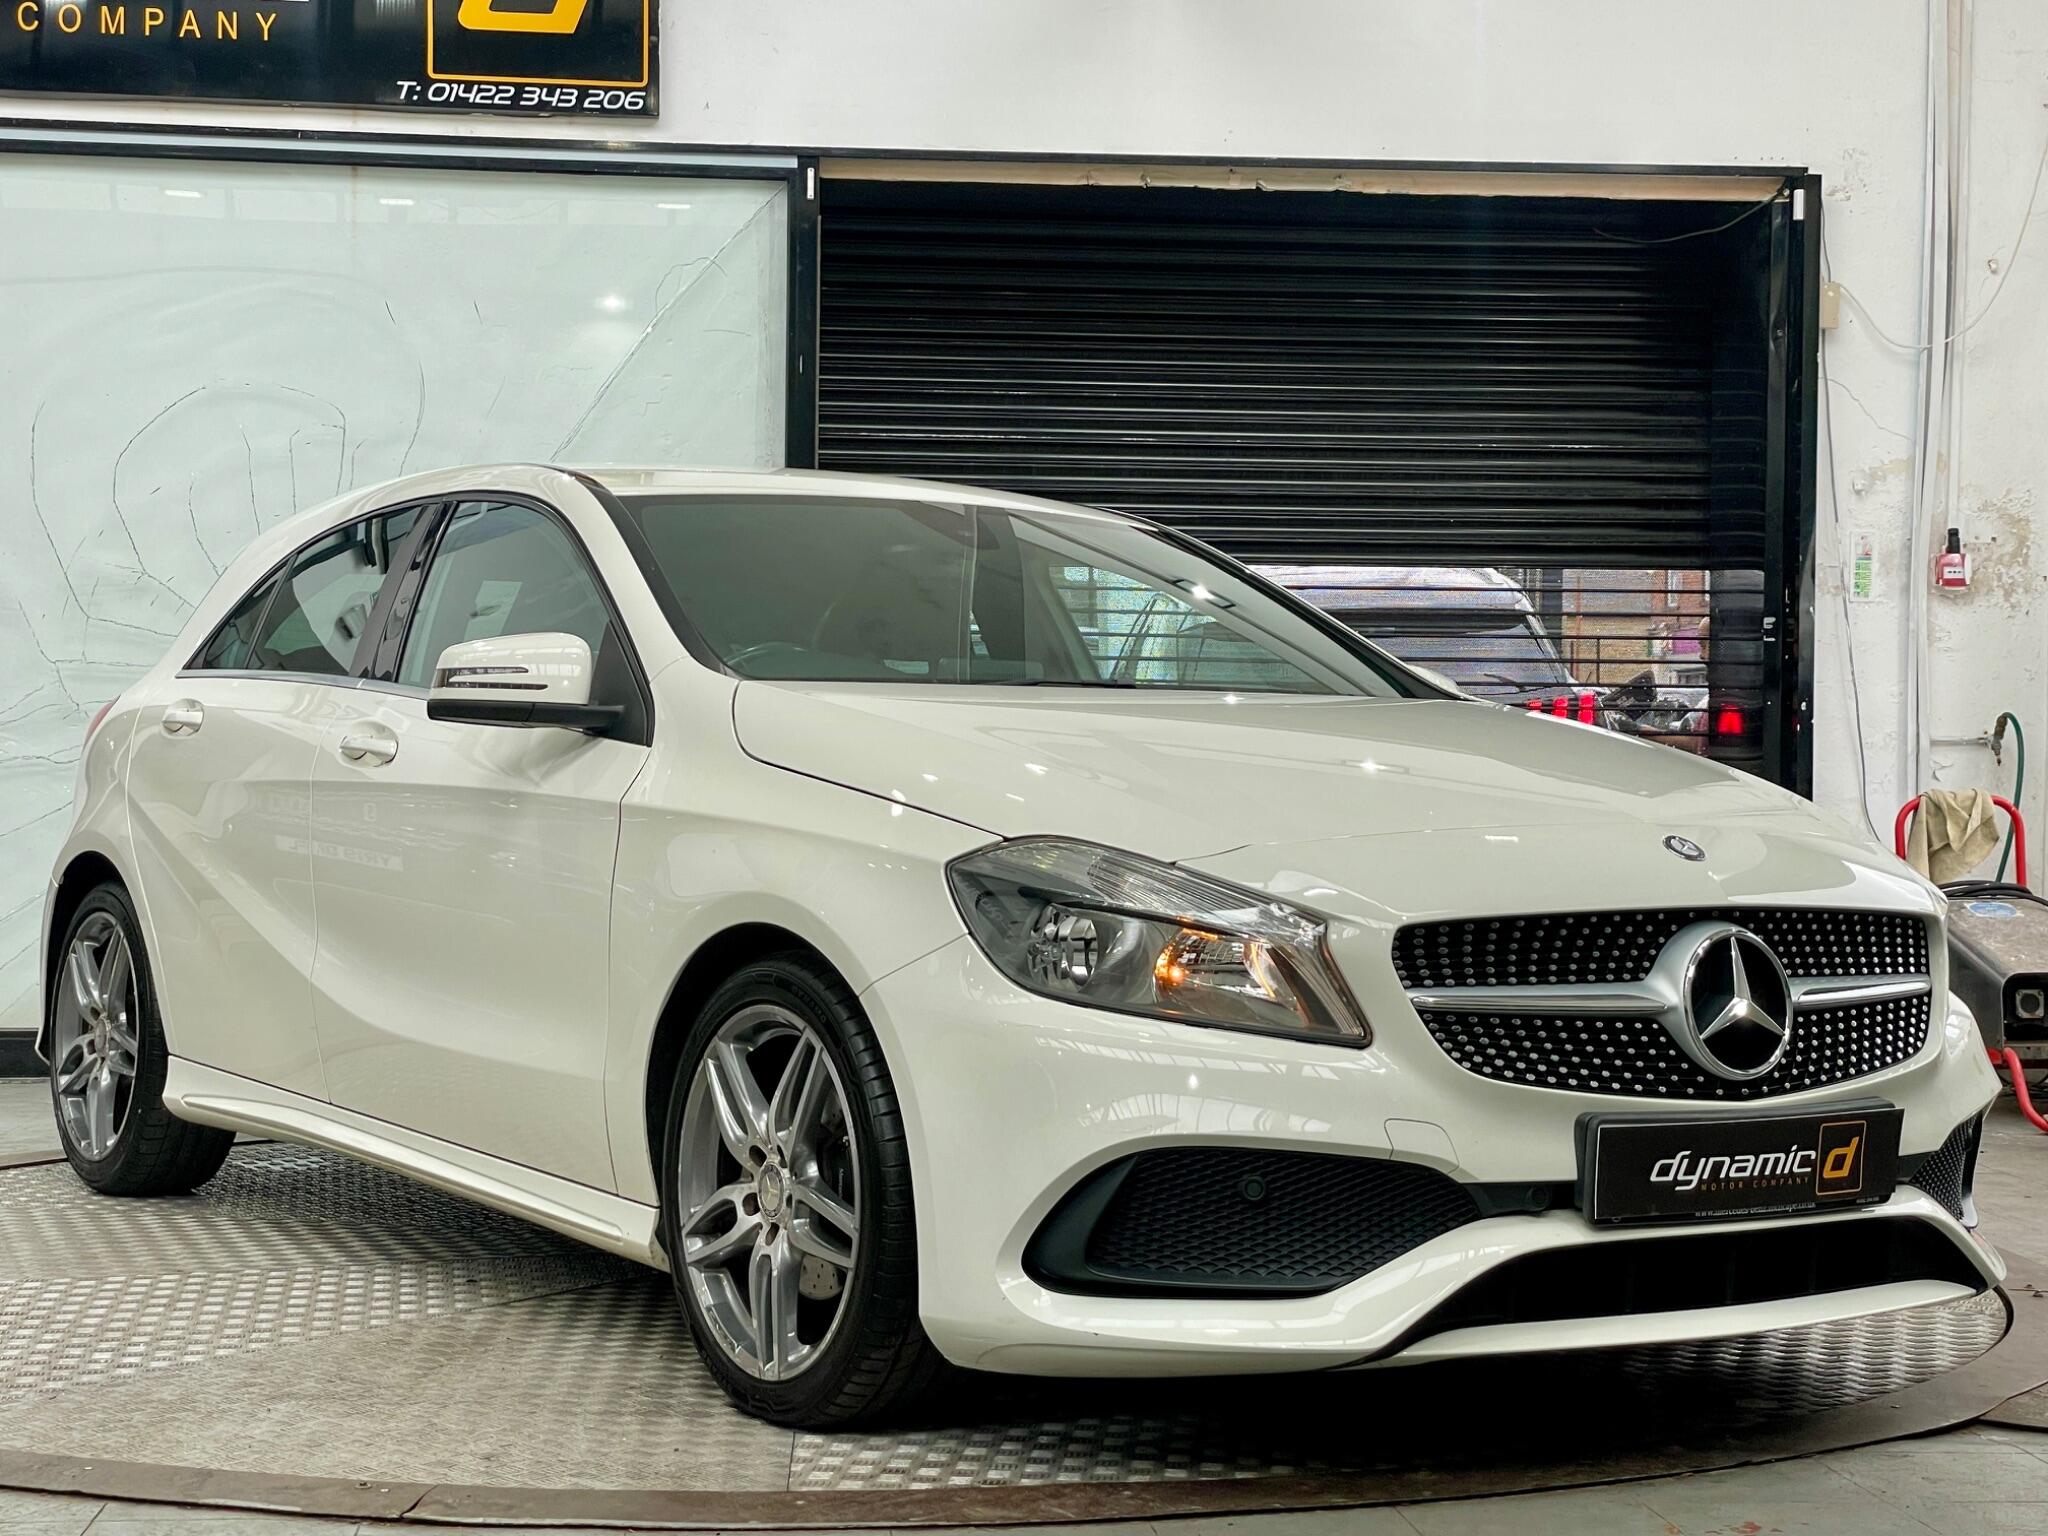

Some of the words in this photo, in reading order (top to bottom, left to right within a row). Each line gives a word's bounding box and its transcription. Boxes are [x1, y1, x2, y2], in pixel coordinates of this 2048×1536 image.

[17, 1, 277, 41] COMPANY
[396, 80, 421, 101] T:
[427, 82, 515, 105] 01422
[519, 87, 578, 108] 343
[583, 89, 646, 110] 206
[1650, 1144, 1816, 1191] dynamic
[1822, 1136, 1860, 1179] d
[1701, 1181, 1744, 1191] MOTOR
[1752, 1176, 1810, 1188] COMPANY
